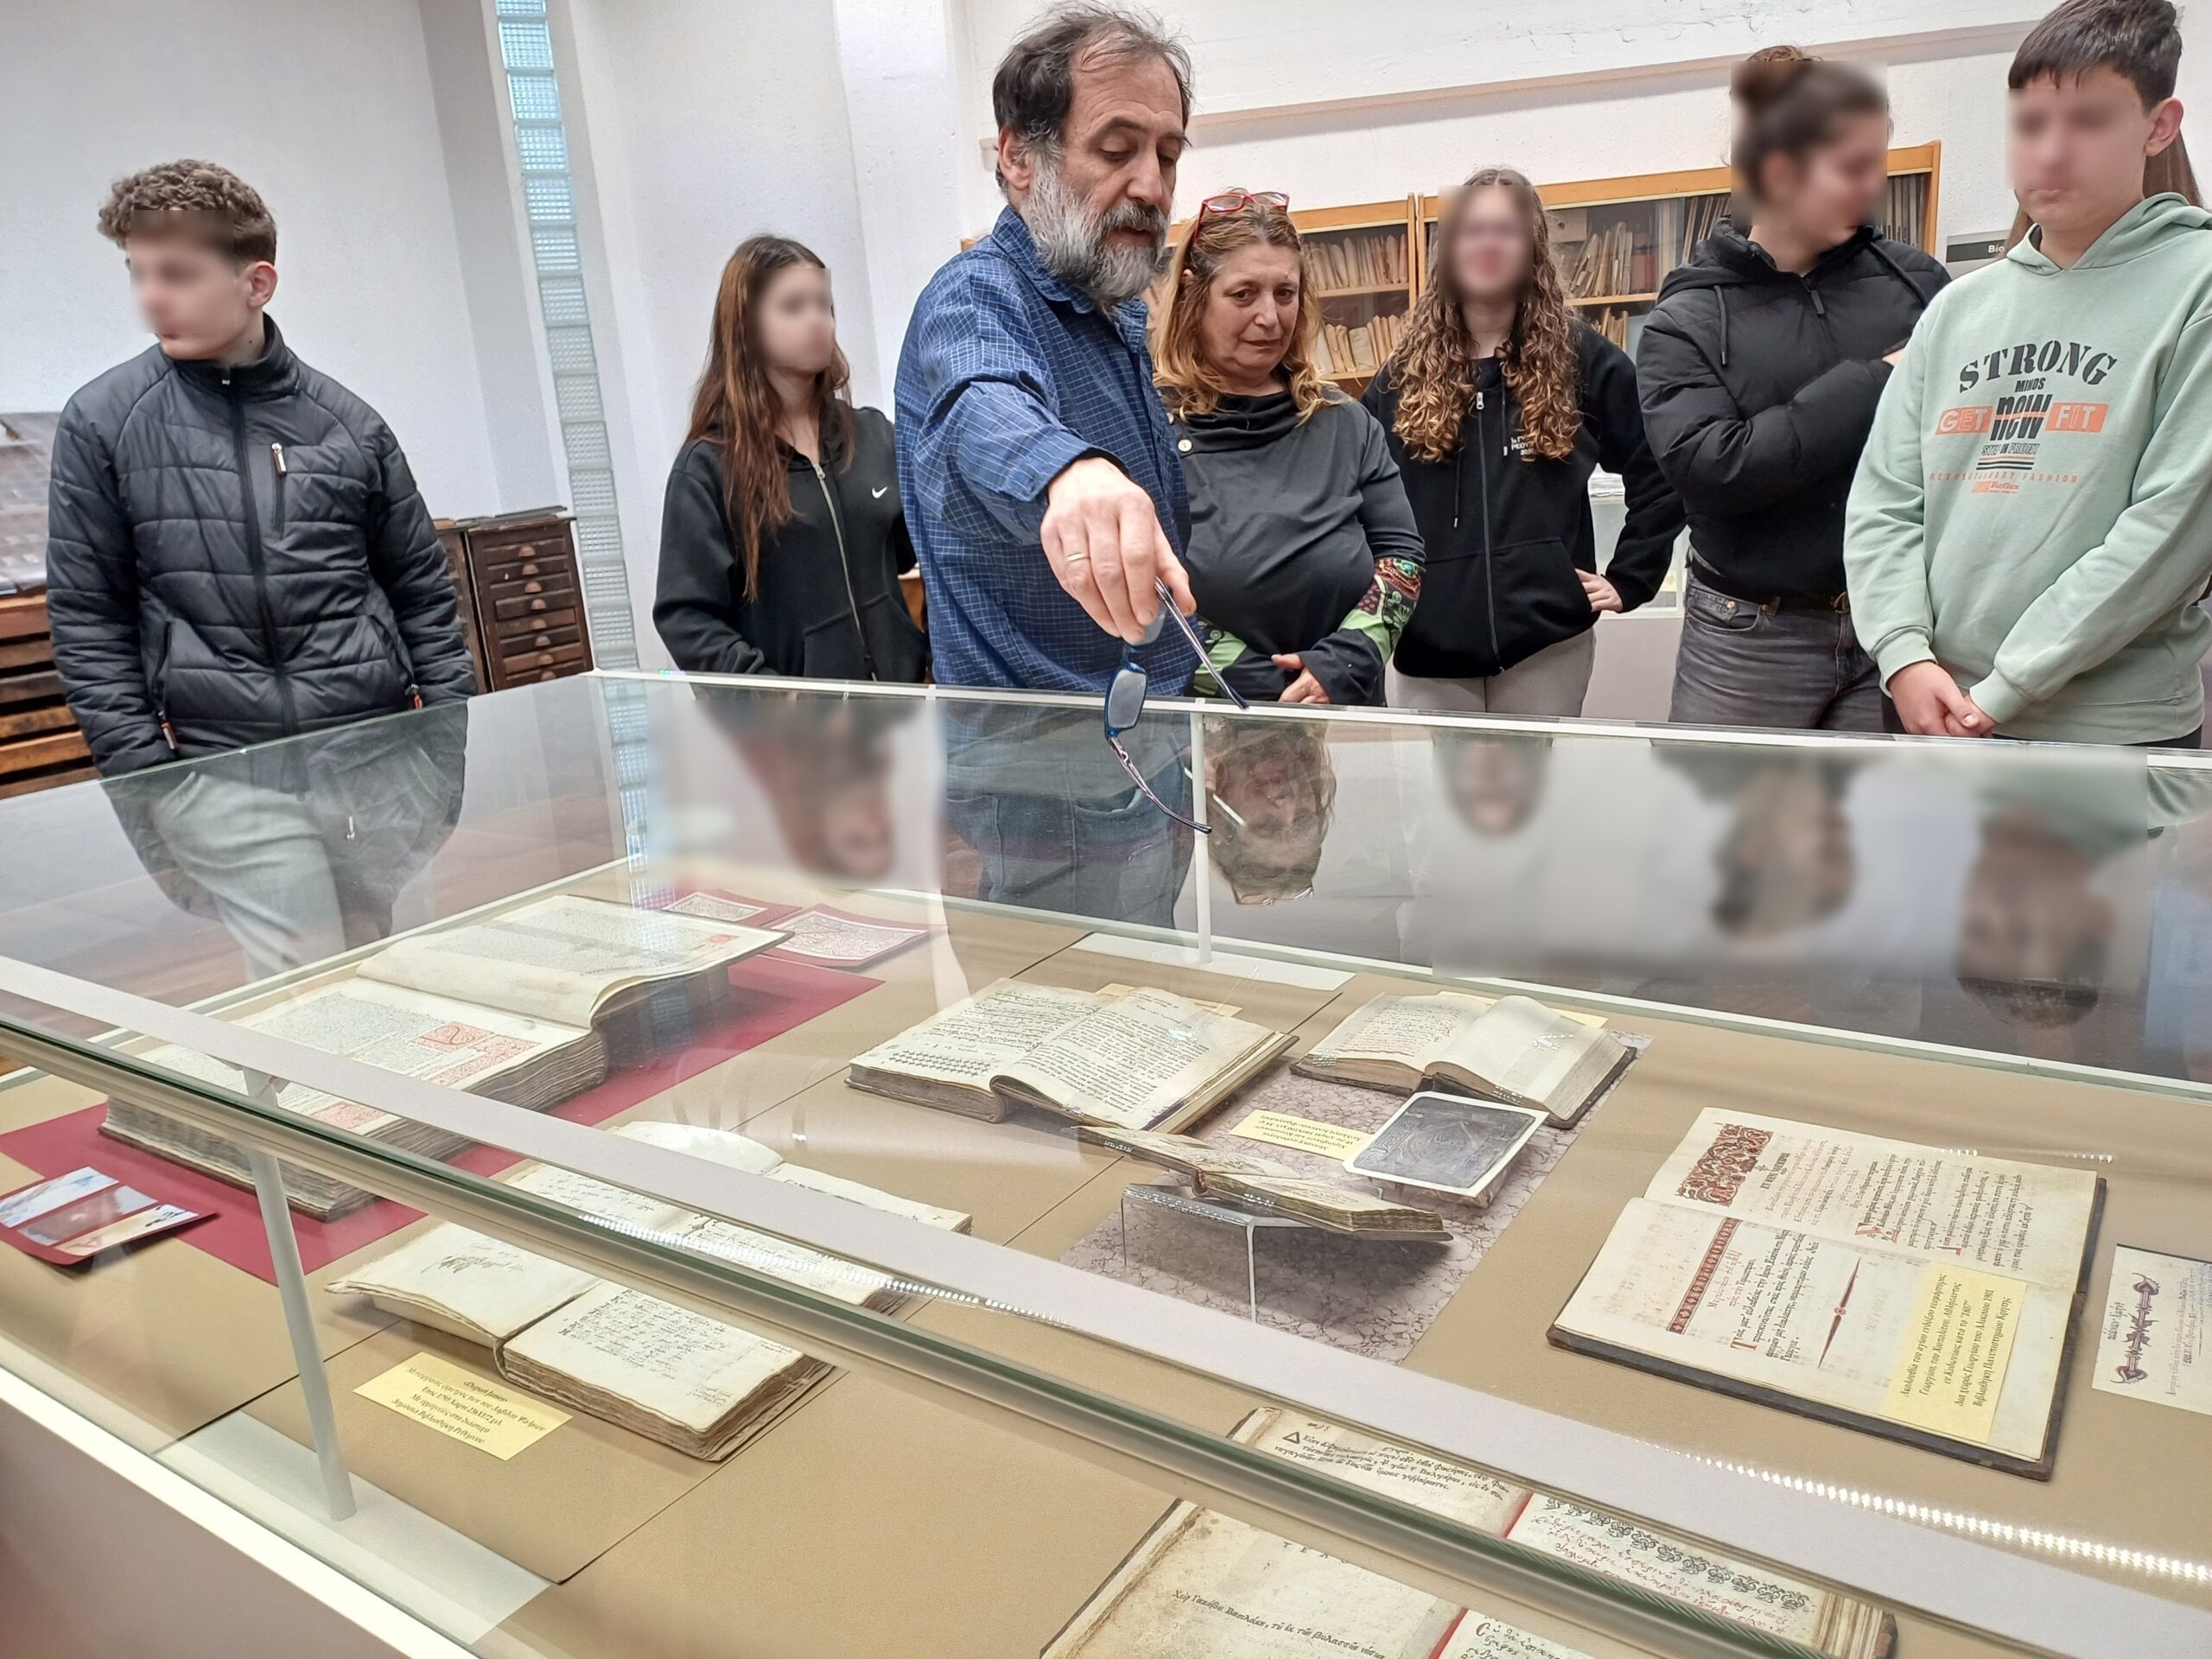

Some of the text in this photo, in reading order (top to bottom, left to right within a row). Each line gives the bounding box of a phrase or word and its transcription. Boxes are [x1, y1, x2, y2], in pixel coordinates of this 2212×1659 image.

[1960, 340, 2117, 394] STRONG
[2015, 378, 2046, 392] MINDS
[1939, 409, 1988, 432] GET
[2055, 406, 2096, 429] FIT
[2023, 473, 2080, 483] FASHION
[1922, 1310, 1935, 1334] ενδόξου
[1974, 1331, 1983, 1343] του
[1986, 1289, 1994, 1301] 1901
[1917, 1334, 1928, 1351] αγίου
[1973, 1297, 2012, 1407] Βιβλιοθήκη Πανεπιστημίου Κρήτης
[1913, 1352, 1922, 1363] του
[1931, 1352, 1940, 1364] του
